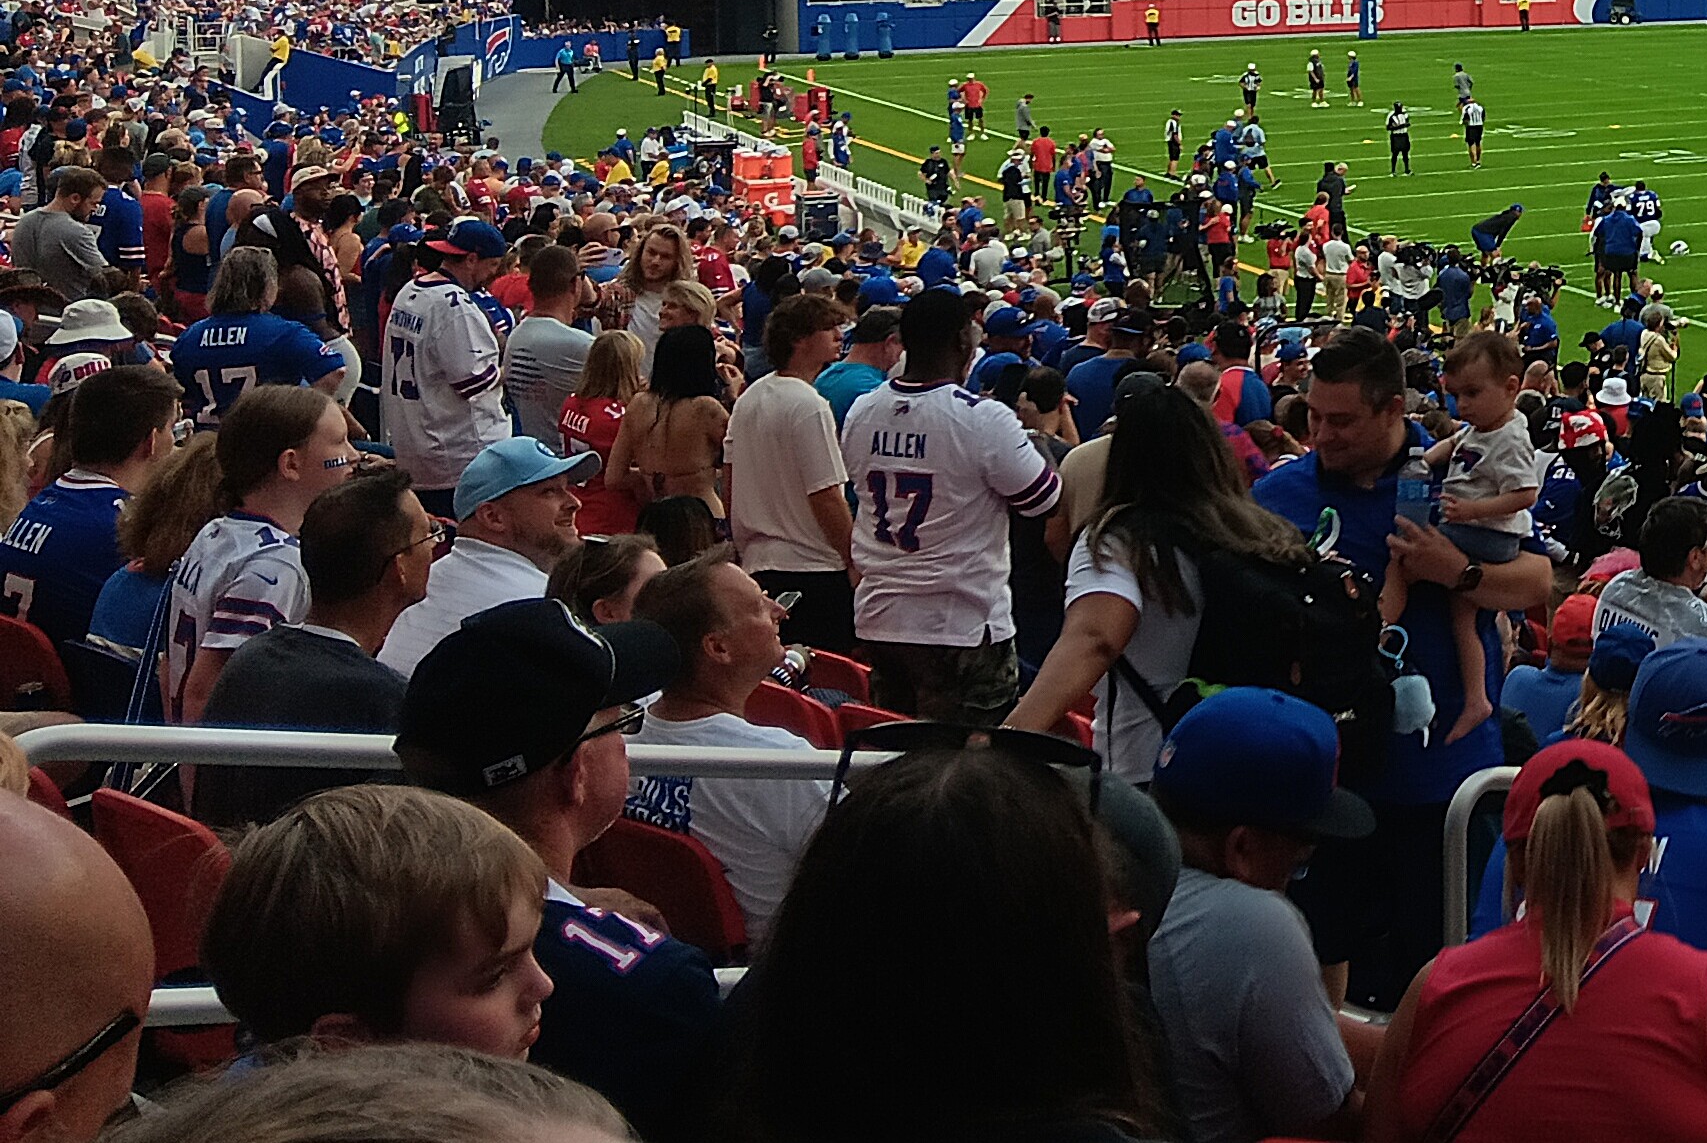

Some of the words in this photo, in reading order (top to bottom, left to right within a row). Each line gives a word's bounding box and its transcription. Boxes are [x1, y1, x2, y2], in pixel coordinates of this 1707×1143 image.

[1232, 0, 1280, 28] GO
[1636, 200, 1655, 216] 79
[200, 327, 246, 347] ALLEN
[195, 365, 256, 425] 17
[562, 410, 589, 433] ALLEN
[871, 431, 926, 459] ALLEN
[866, 471, 933, 553] 17
[3, 518, 52, 554] ALLEN
